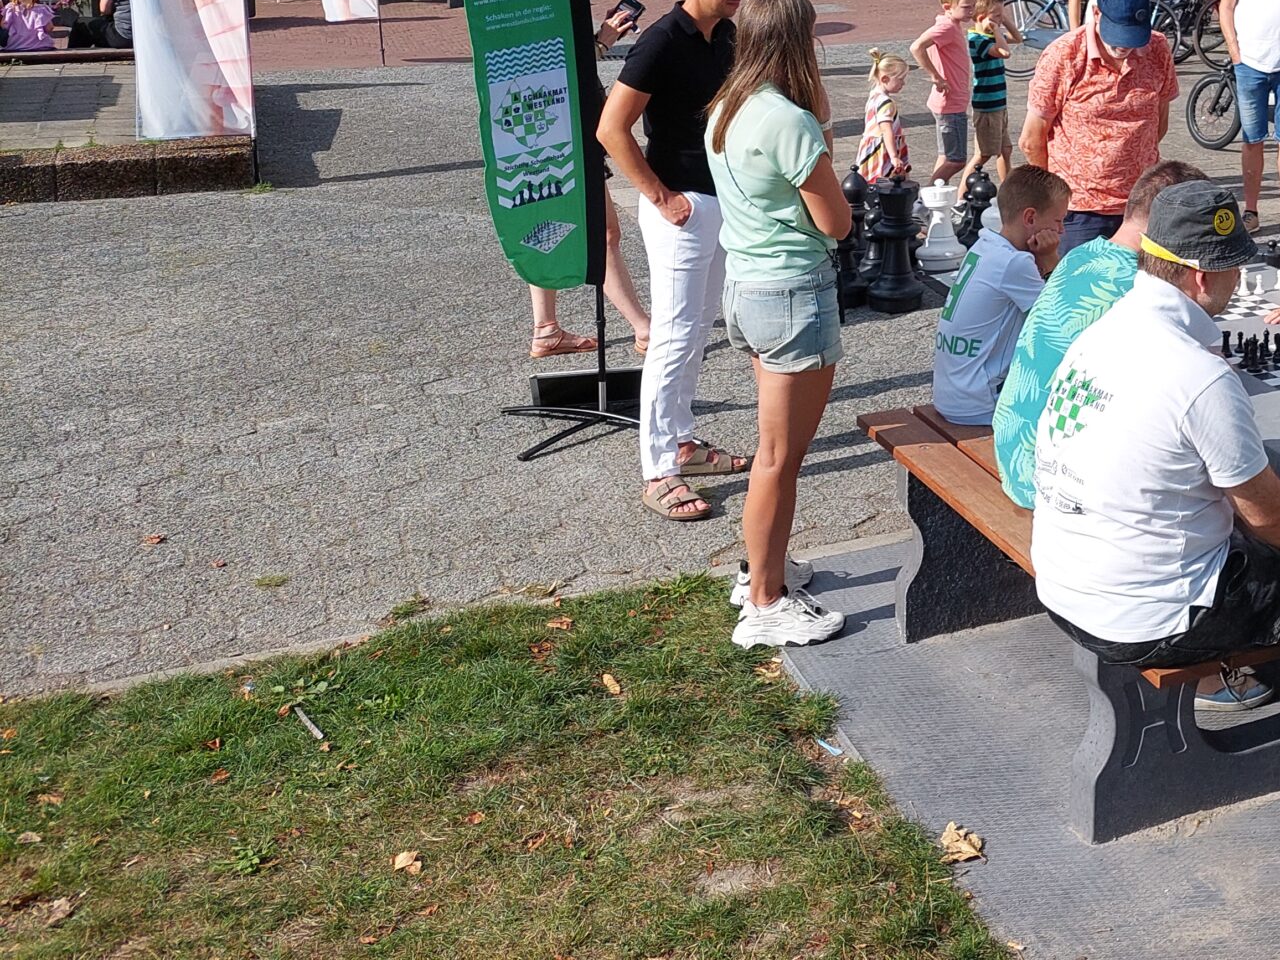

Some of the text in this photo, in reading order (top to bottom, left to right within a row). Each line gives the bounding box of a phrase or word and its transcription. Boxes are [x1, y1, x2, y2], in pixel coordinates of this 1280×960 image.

[522, 86, 567, 102] SCHAAKMAT
[526, 96, 565, 110] WESTLAND
[1073, 378, 1114, 402] SCHAAKMAT
